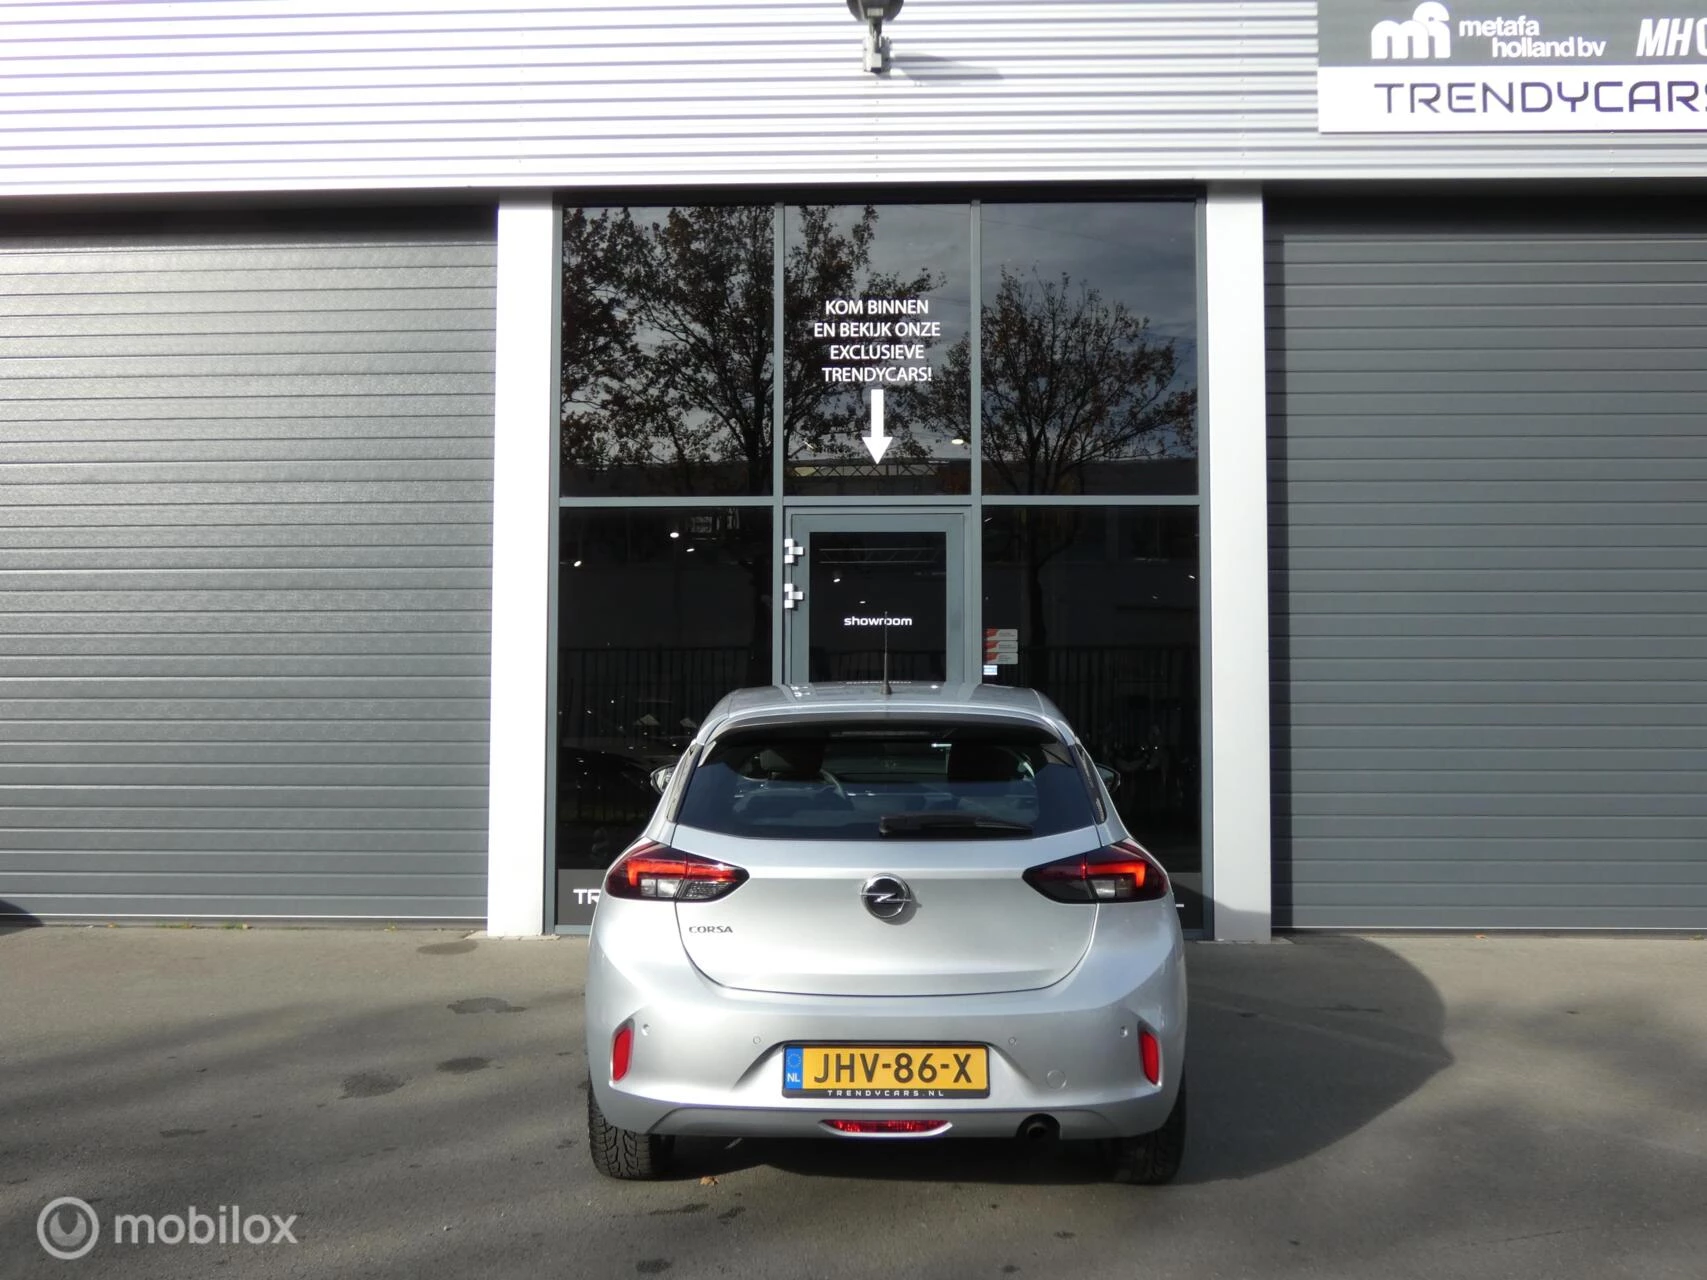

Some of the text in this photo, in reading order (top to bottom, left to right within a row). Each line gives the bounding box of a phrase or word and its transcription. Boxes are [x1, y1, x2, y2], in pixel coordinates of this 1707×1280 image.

[1459, 15, 1540, 37] metafa
[1492, 36, 1606, 58] holland bv
[1374, 81, 1707, 114] TRENDYCAR
[825, 299, 929, 315] KOM BINNEN
[814, 321, 941, 337] EN BEKIJK ONZE
[830, 344, 925, 360] EXCLUSIEVE
[822, 366, 932, 382] TRENDYCARS!
[844, 616, 913, 626] showroom
[688, 926, 733, 934] CORSA
[814, 1052, 972, 1084] JHV-86-X
[787, 1073, 800, 1083] NL
